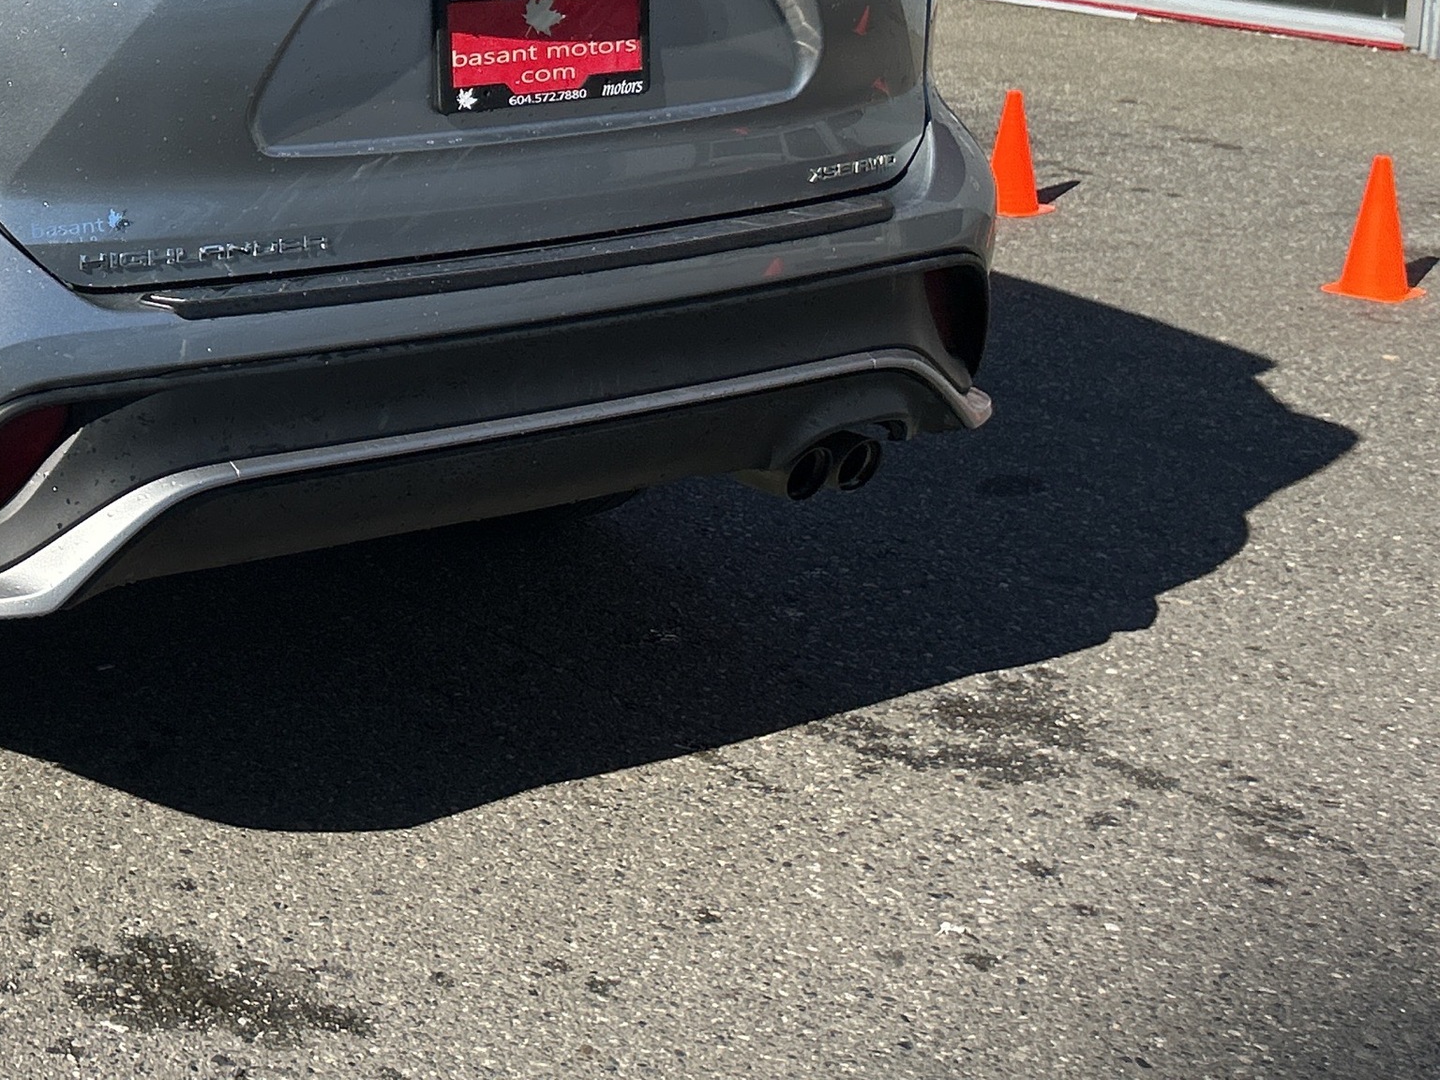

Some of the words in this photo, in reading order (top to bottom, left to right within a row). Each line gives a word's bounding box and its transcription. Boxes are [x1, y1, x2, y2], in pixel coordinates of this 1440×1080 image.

[452, 45, 537, 67] basant
[547, 39, 637, 59] motors
[515, 65, 575, 85] .com
[509, 88, 587, 106] 604.572.7880
[602, 79, 643, 97] motors
[31, 218, 105, 239] basant
